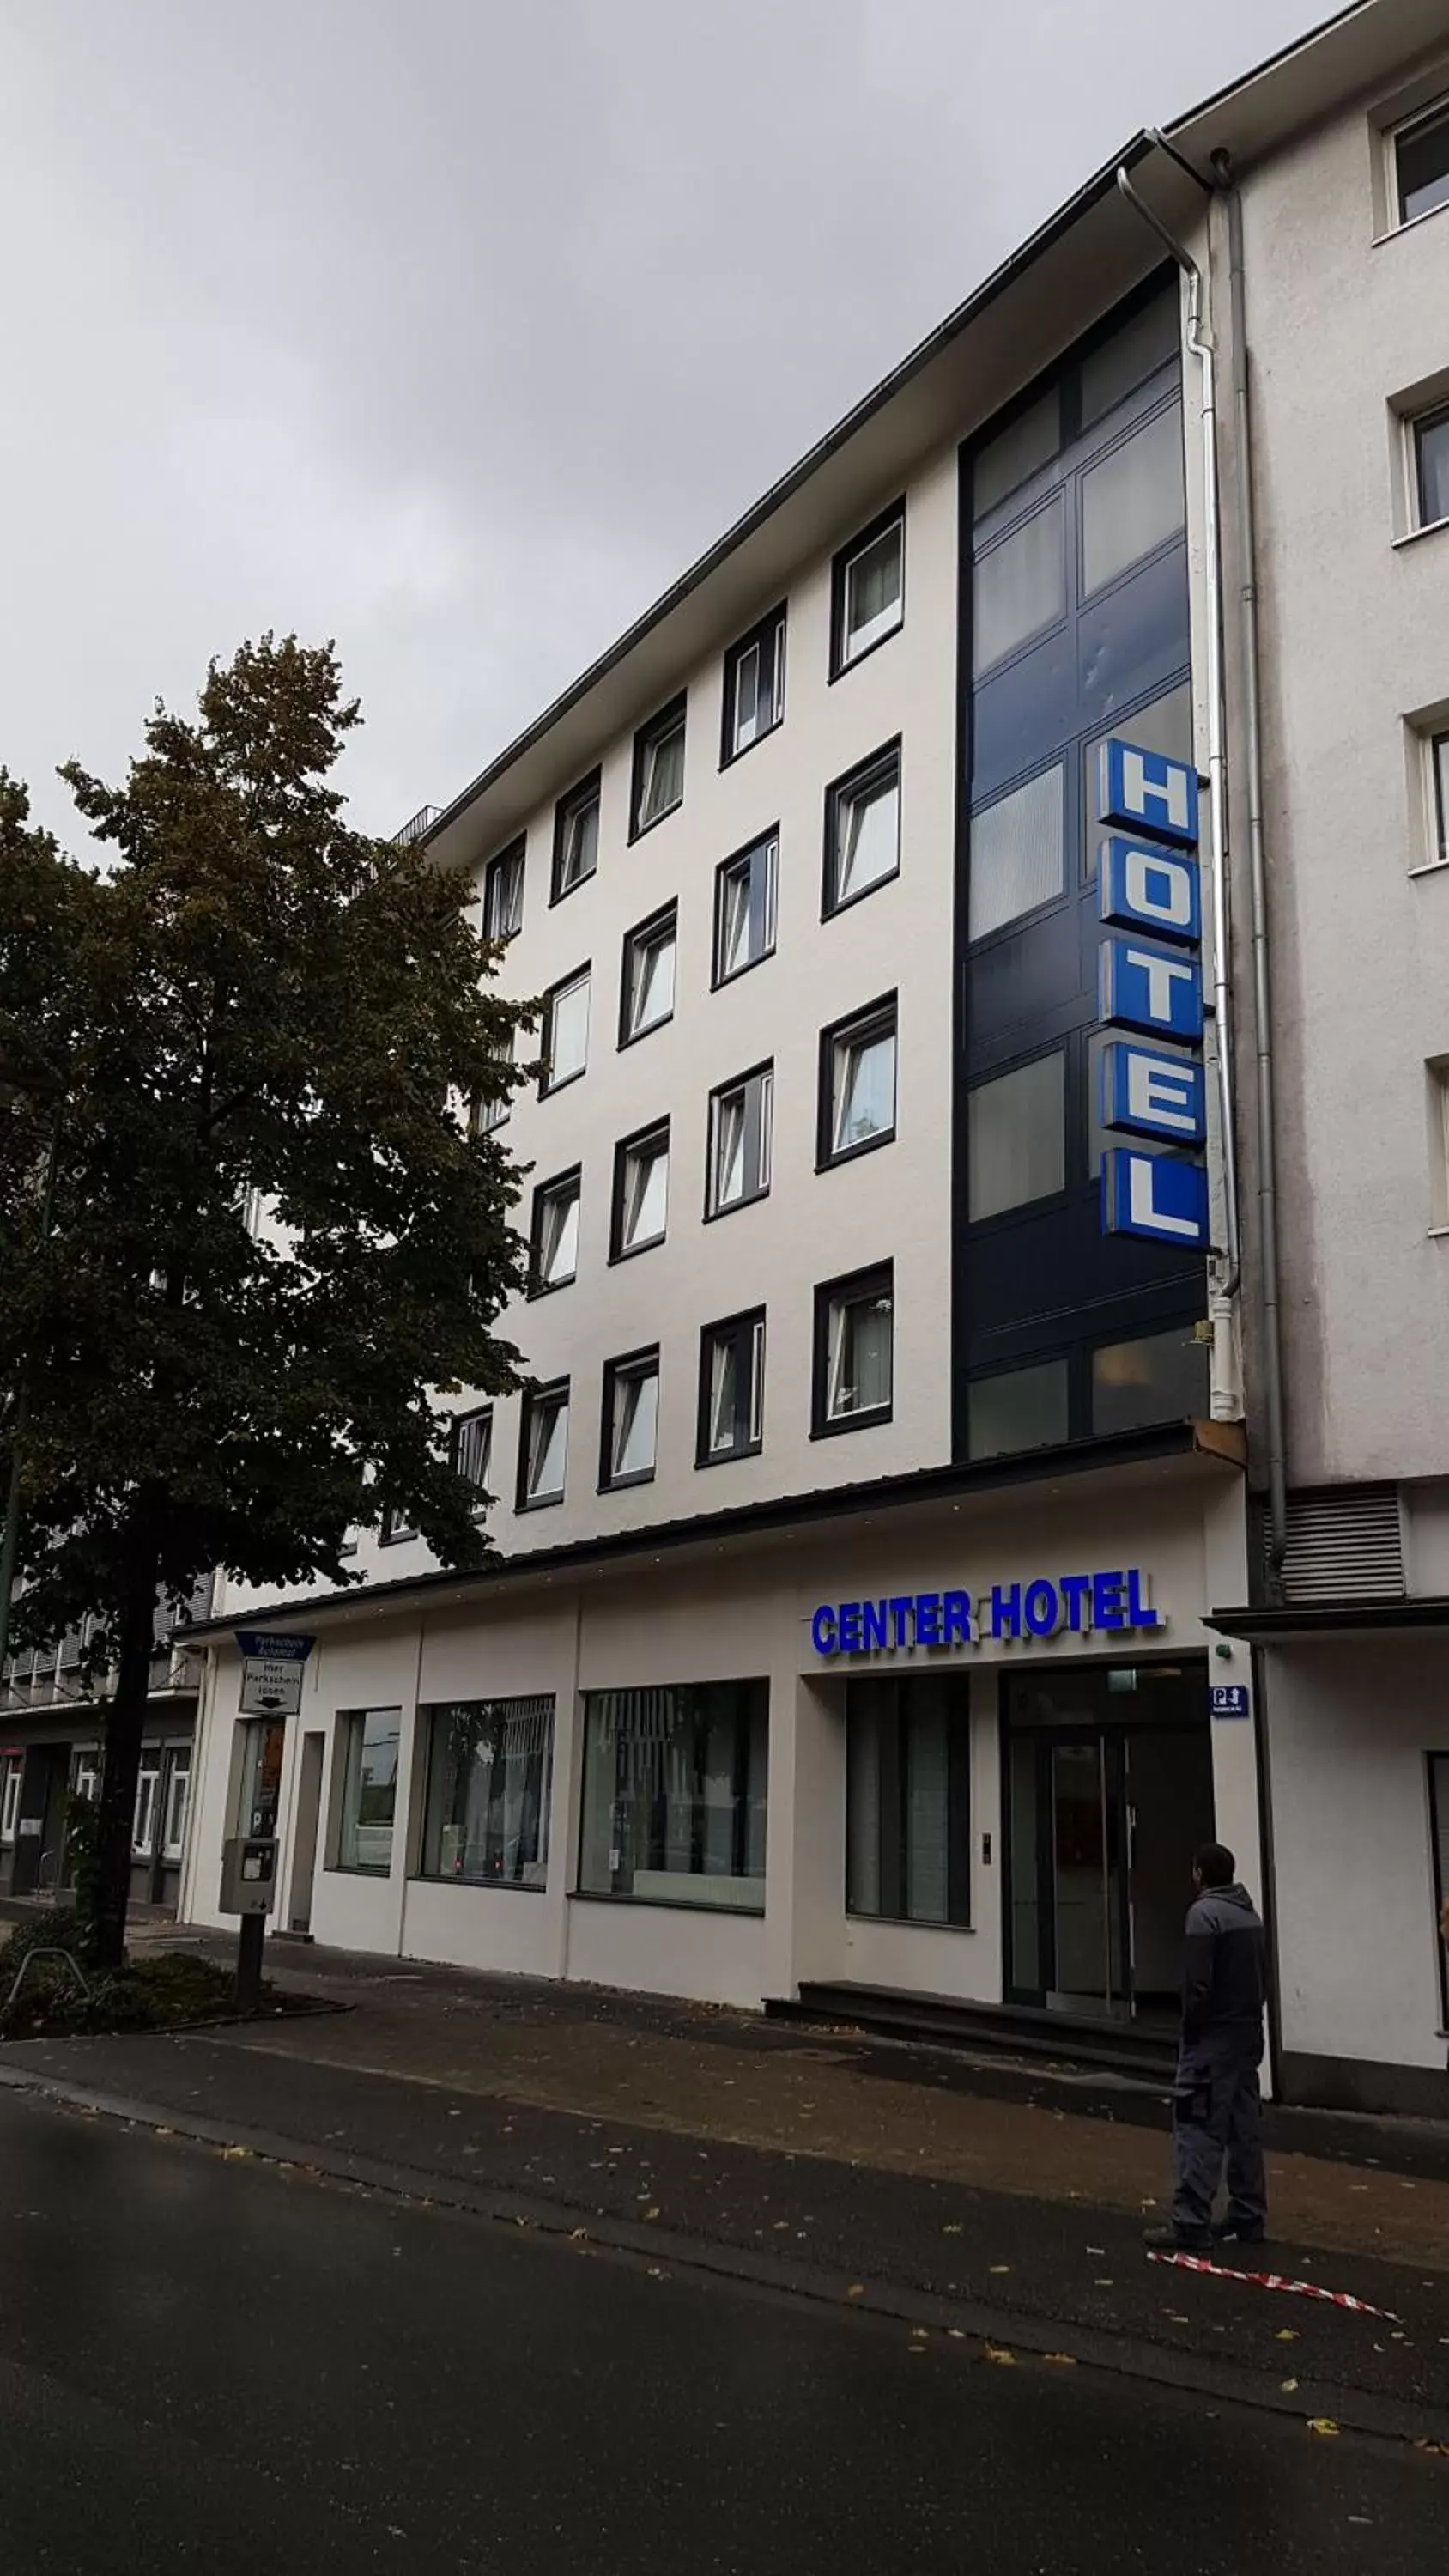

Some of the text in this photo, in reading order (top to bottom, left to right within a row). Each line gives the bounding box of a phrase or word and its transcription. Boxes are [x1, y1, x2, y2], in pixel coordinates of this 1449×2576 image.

[1123, 750, 1199, 1237] HOTEL
[812, 1568, 1157, 1656] CENTER HOTEL
[246, 1674, 300, 1686] Parkschein
